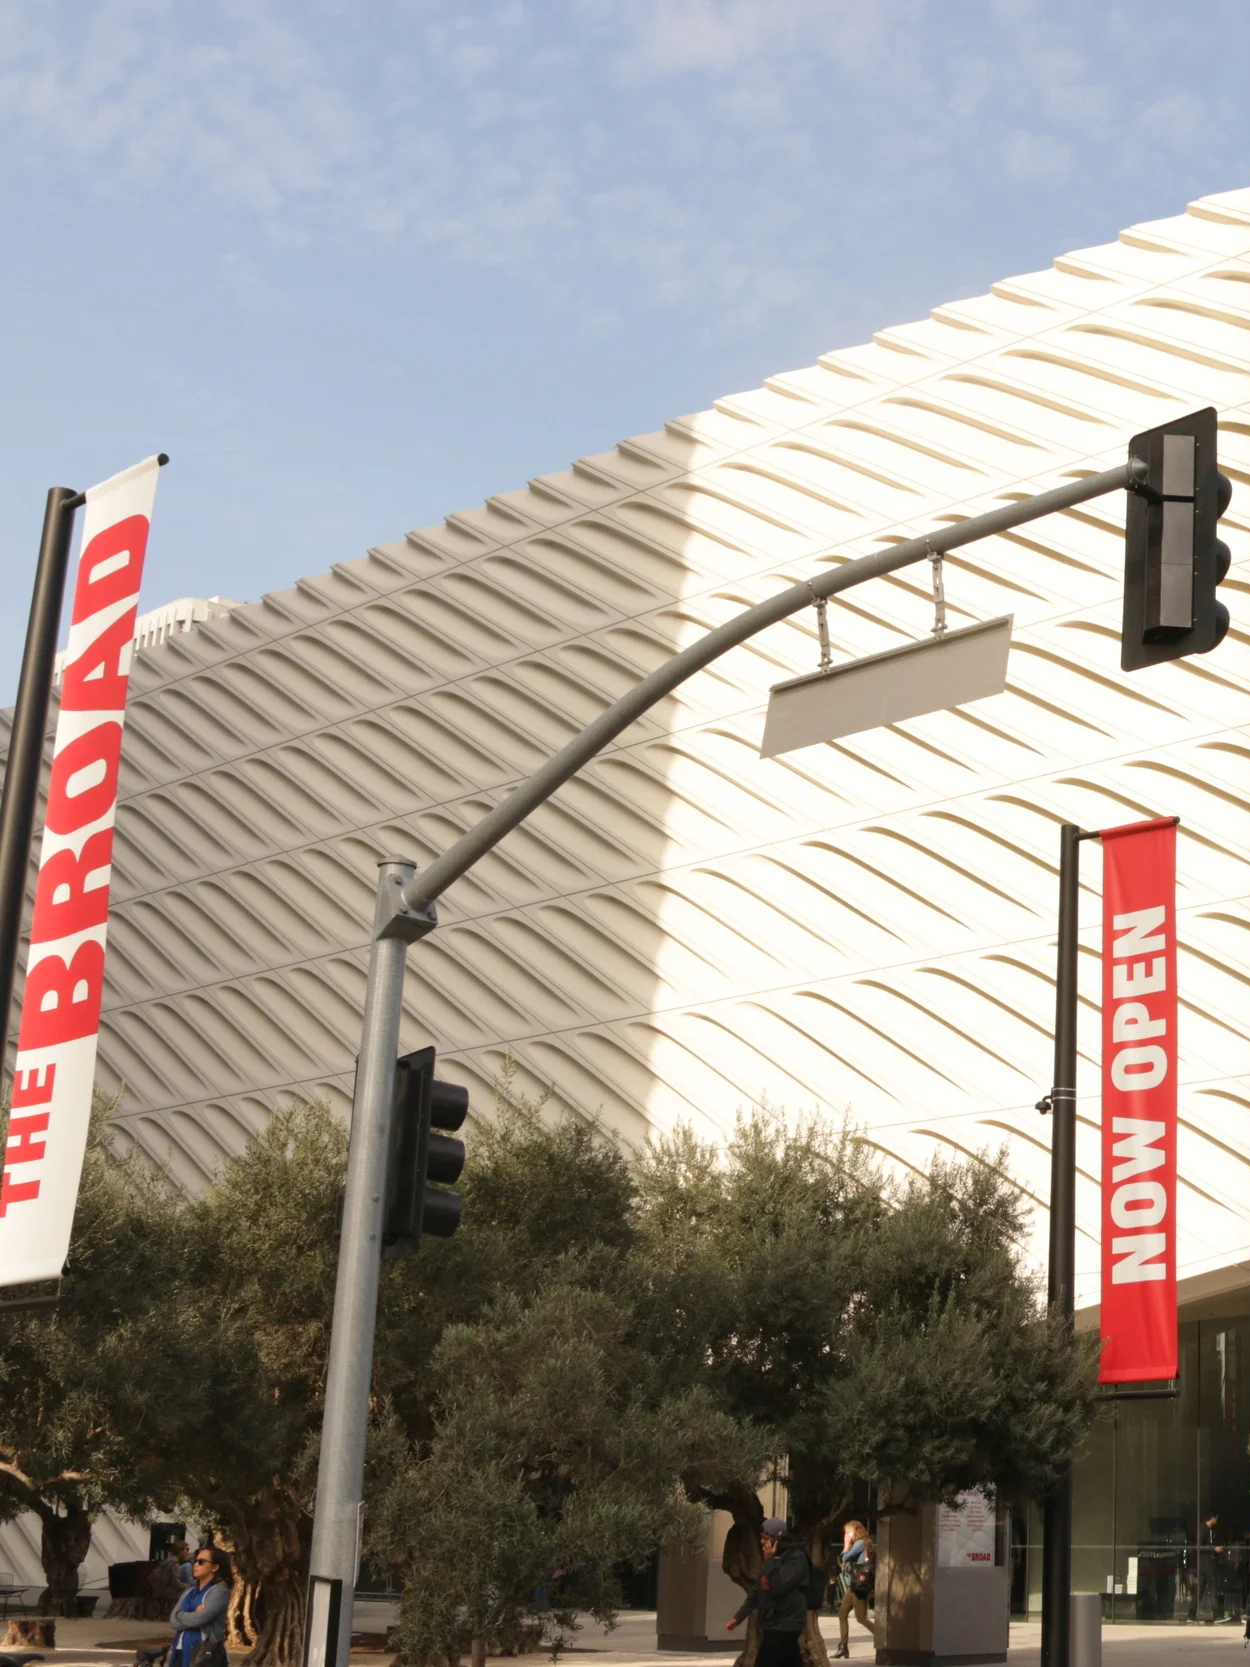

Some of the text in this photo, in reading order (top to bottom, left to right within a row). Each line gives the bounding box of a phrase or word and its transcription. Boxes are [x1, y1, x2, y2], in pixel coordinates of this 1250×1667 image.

[0, 513, 150, 1218] THE BROAD
[1110, 904, 1168, 1284] NOW OPEN
[972, 1553, 991, 1561] BROAD
